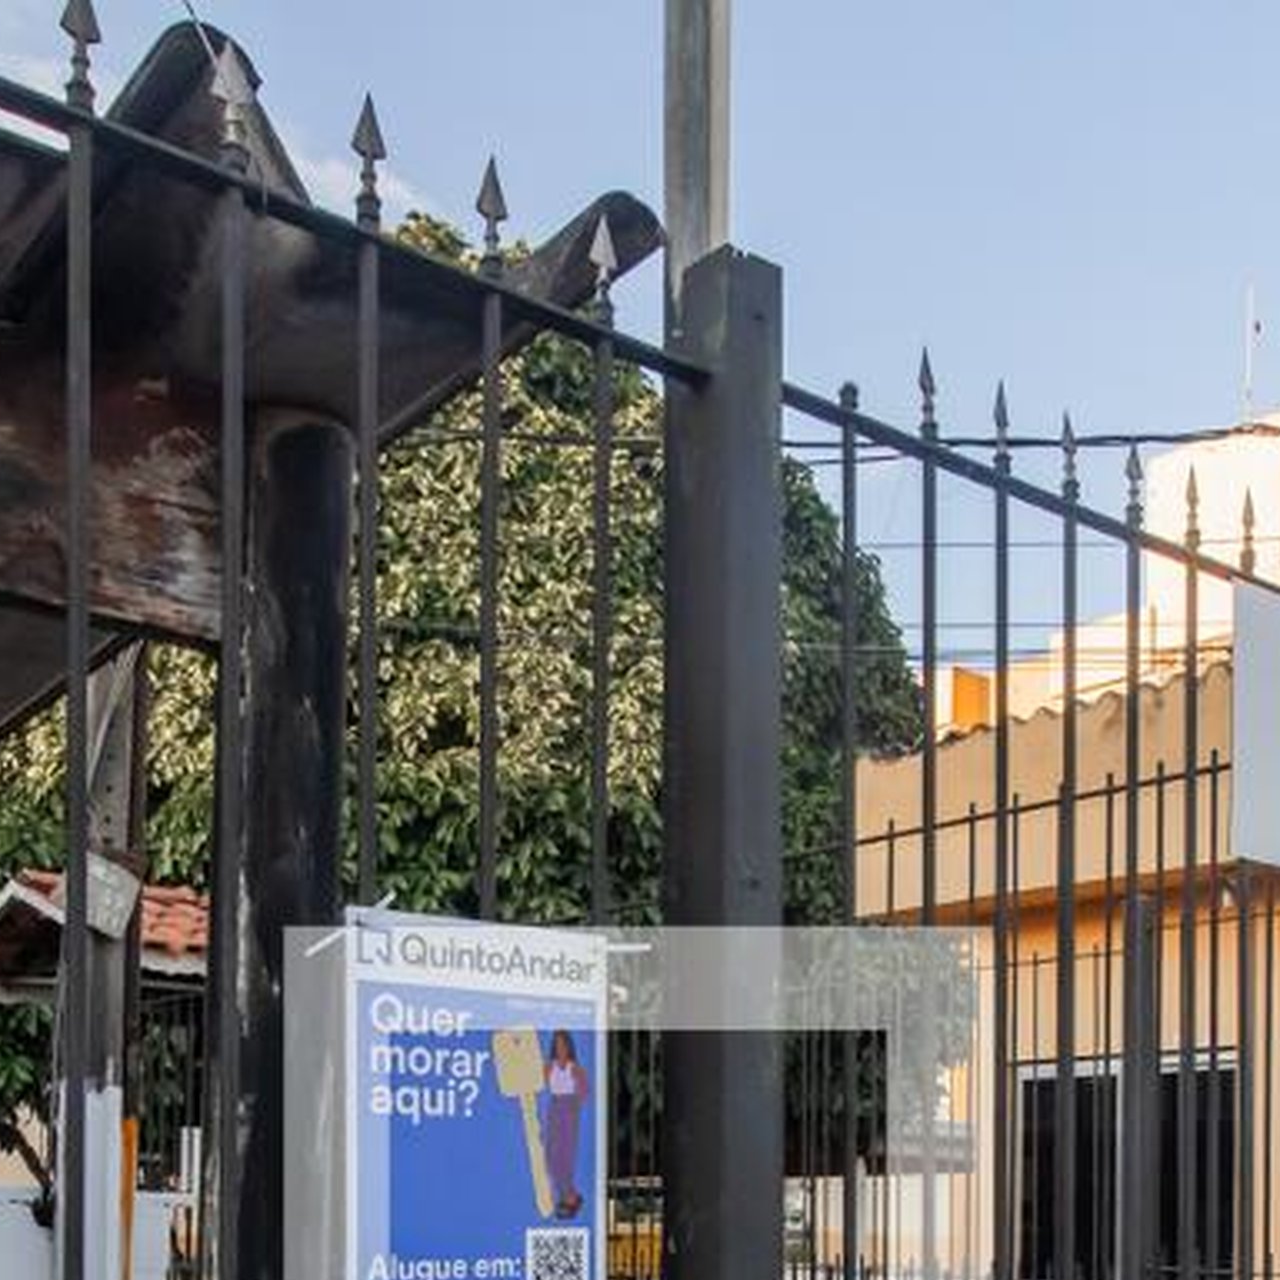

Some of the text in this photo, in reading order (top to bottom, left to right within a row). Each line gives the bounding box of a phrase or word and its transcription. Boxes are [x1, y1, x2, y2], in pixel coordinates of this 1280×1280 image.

[399, 933, 598, 984] QuintoAndar
[370, 993, 472, 1038] Quer
[371, 1044, 489, 1078] morar
[370, 1080, 480, 1126] aqui?
[474, 1257, 521, 1280] em:
